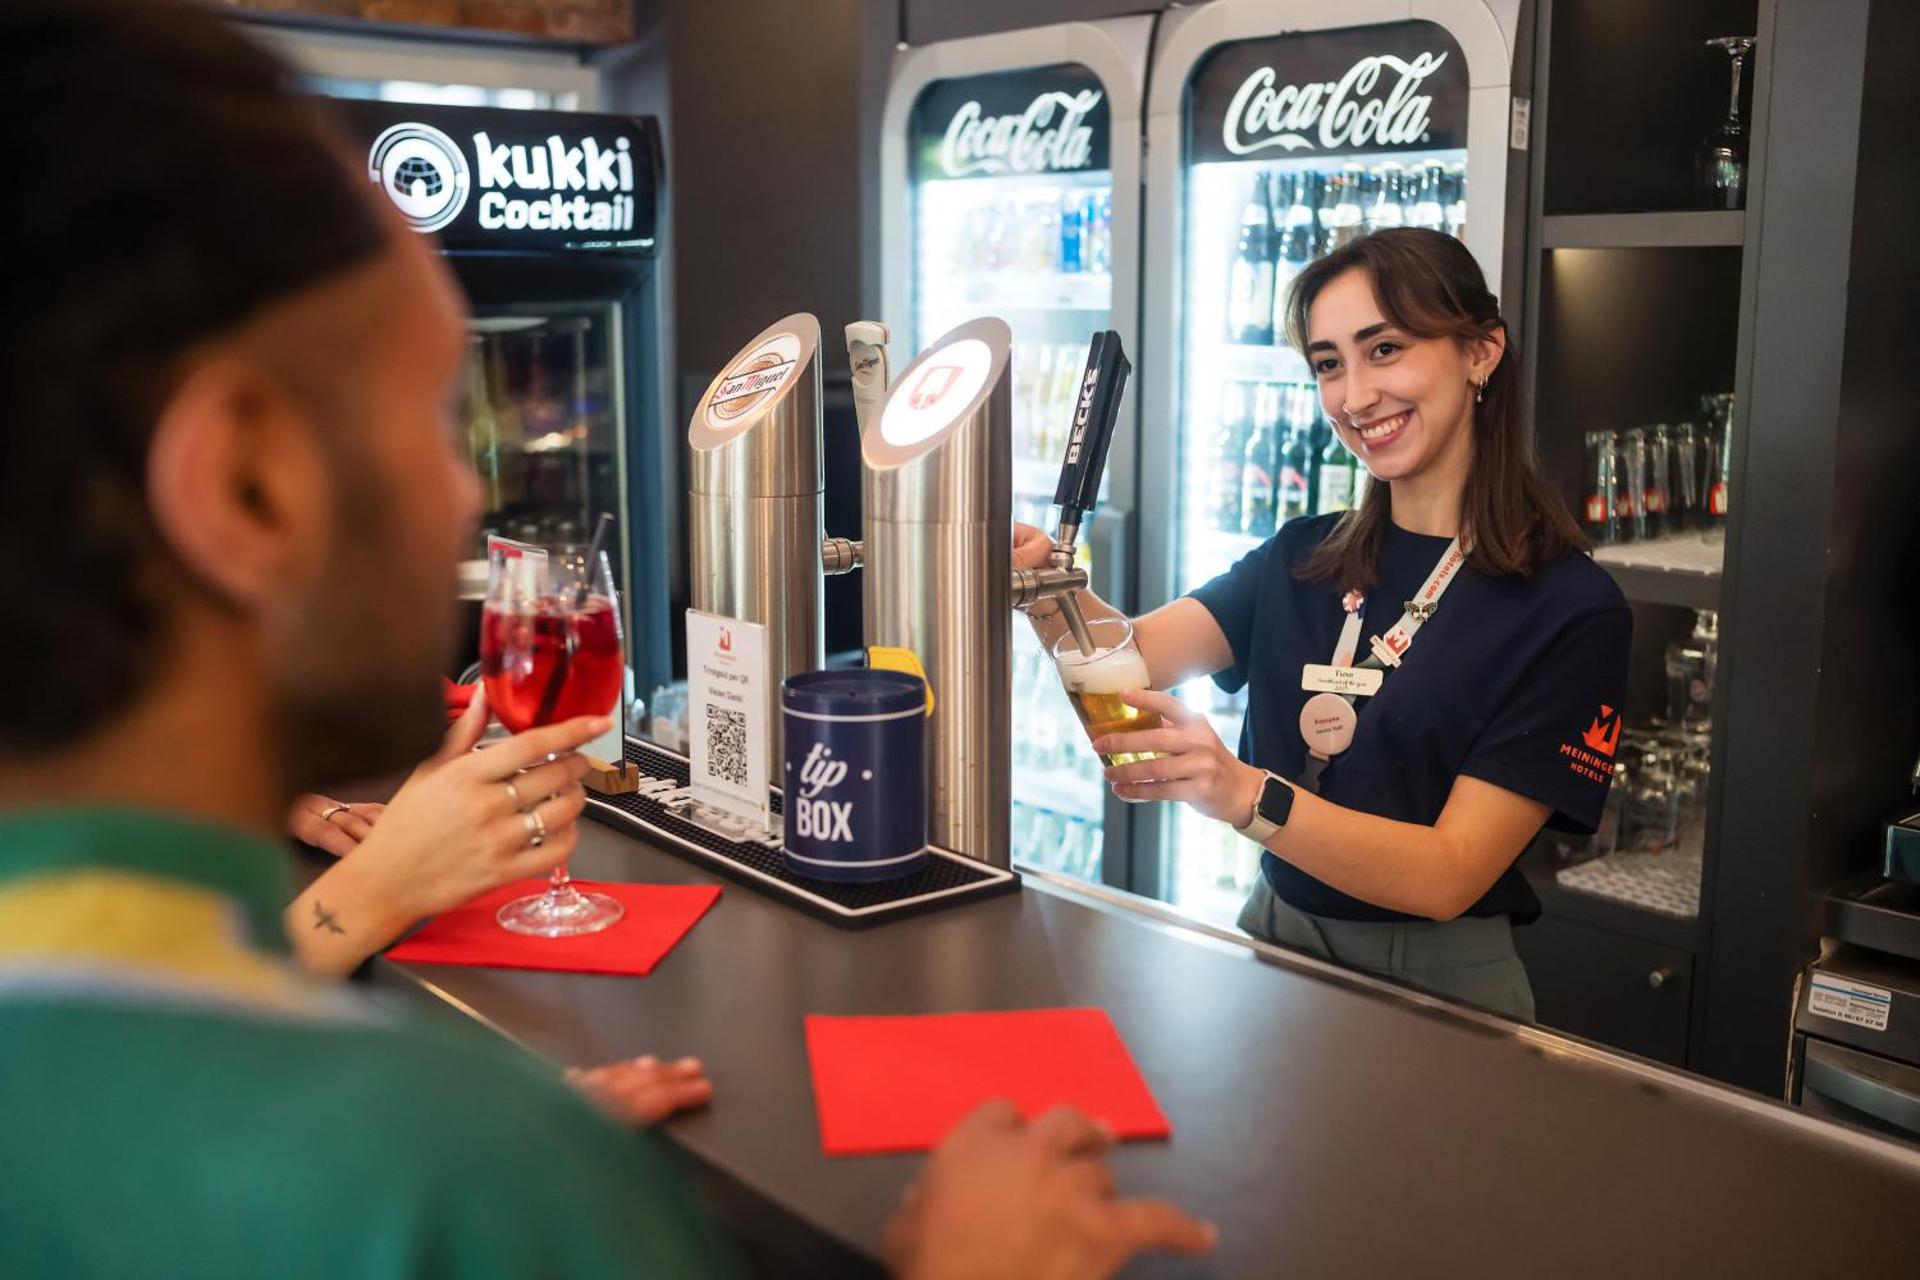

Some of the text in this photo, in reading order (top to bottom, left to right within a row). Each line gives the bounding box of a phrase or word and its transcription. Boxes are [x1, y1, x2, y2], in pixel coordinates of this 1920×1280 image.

[1223, 51, 1448, 155] Coca-Cola
[473, 131, 633, 191] kukki
[478, 191, 634, 231] Cocktail
[712, 366, 790, 400] San Miguel
[799, 742, 847, 798] tip
[1570, 761, 1604, 783] HOTELS
[796, 797, 853, 842] BOX
